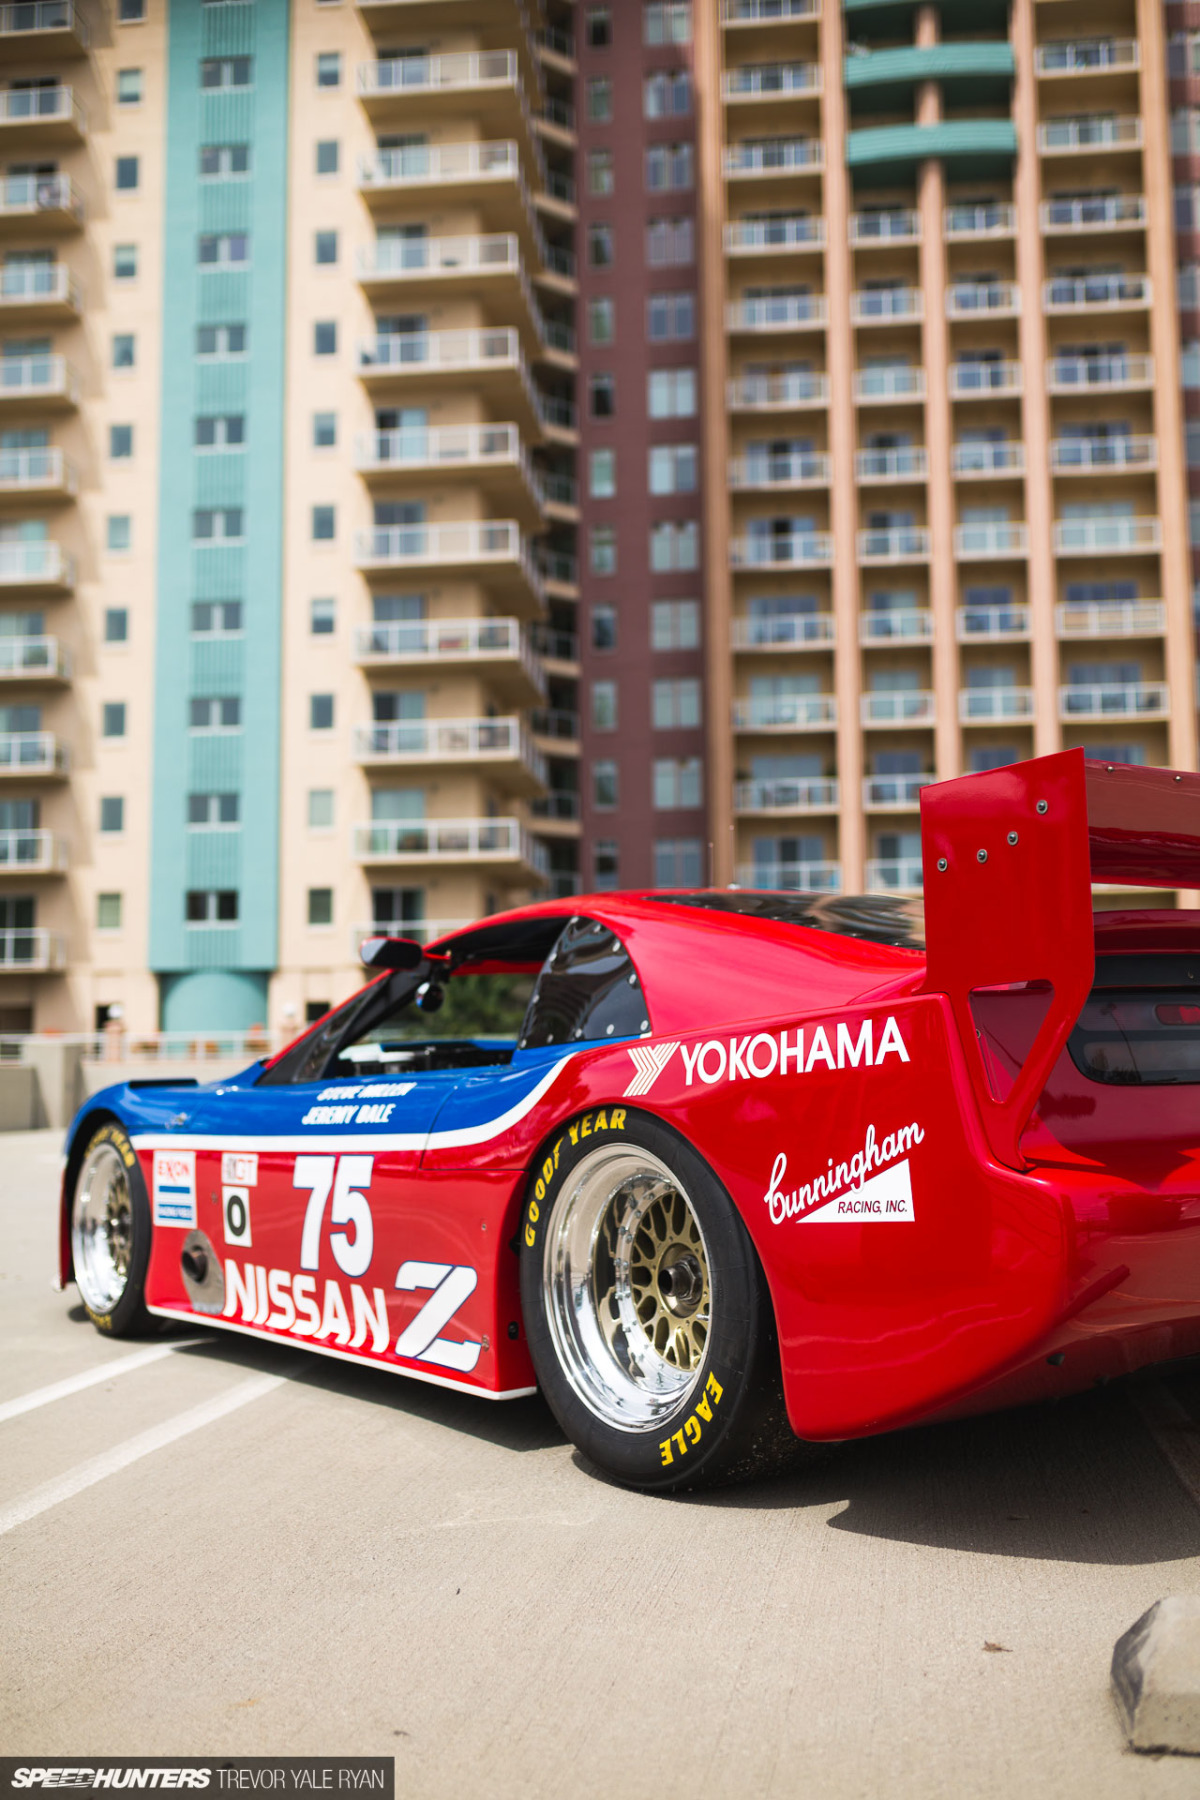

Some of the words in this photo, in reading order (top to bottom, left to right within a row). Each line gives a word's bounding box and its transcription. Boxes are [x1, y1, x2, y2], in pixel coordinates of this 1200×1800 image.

[680, 1016, 910, 1086] YOKOHAMA
[301, 1105, 360, 1124] JEREMY
[355, 1103, 397, 1124] DALE
[293, 1154, 374, 1277] 75
[764, 1122, 925, 1225] Cunningham
[838, 1200, 882, 1216] RACING,
[885, 1199, 908, 1214] INC.
[223, 1258, 390, 1354] NISSAN
[395, 1260, 482, 1374] Z
[659, 1370, 724, 1467] EAGLE
